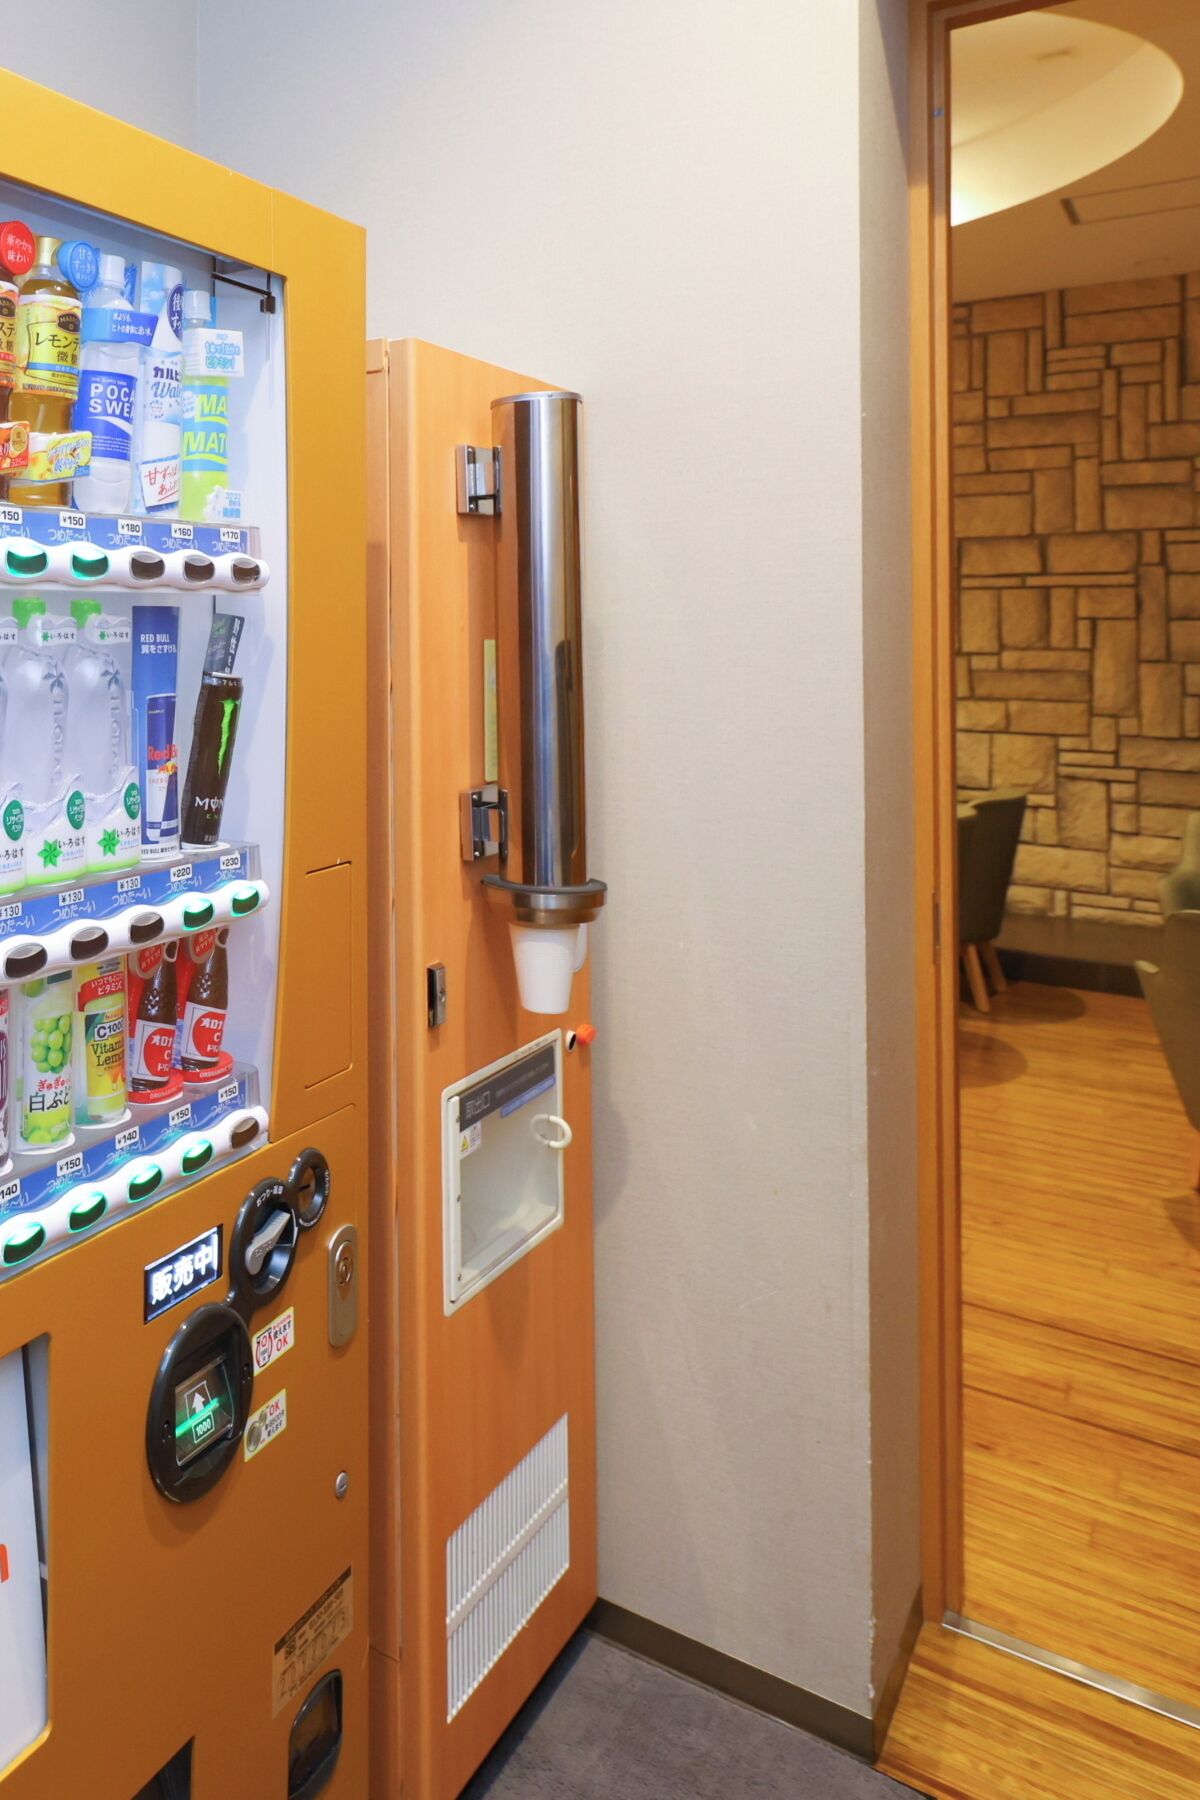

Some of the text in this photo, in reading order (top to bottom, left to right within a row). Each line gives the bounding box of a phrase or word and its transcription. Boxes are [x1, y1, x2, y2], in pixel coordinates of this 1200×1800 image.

[62, 516, 84, 527] ¥150
[121, 523, 141, 533] ¥180
[173, 527, 192, 537] ¥160
[222, 530, 239, 540] ¥170
[140, 633, 170, 643] RED BULL
[221, 856, 239, 867] ¥230
[172, 866, 191, 878] ¥220
[119, 878, 139, 890] ¥130
[60, 889, 82, 903] ¥130
[220, 1086, 237, 1101] ¥150
[171, 1108, 191, 1124] ¥150
[116, 1130, 137, 1147] ¥140
[58, 1156, 81, 1174] ¥150
[152, 1249, 216, 1305] 販売中
[276, 1334, 289, 1352] OK
[269, 1400, 280, 1416] OK
[195, 1419, 212, 1437] 1000
